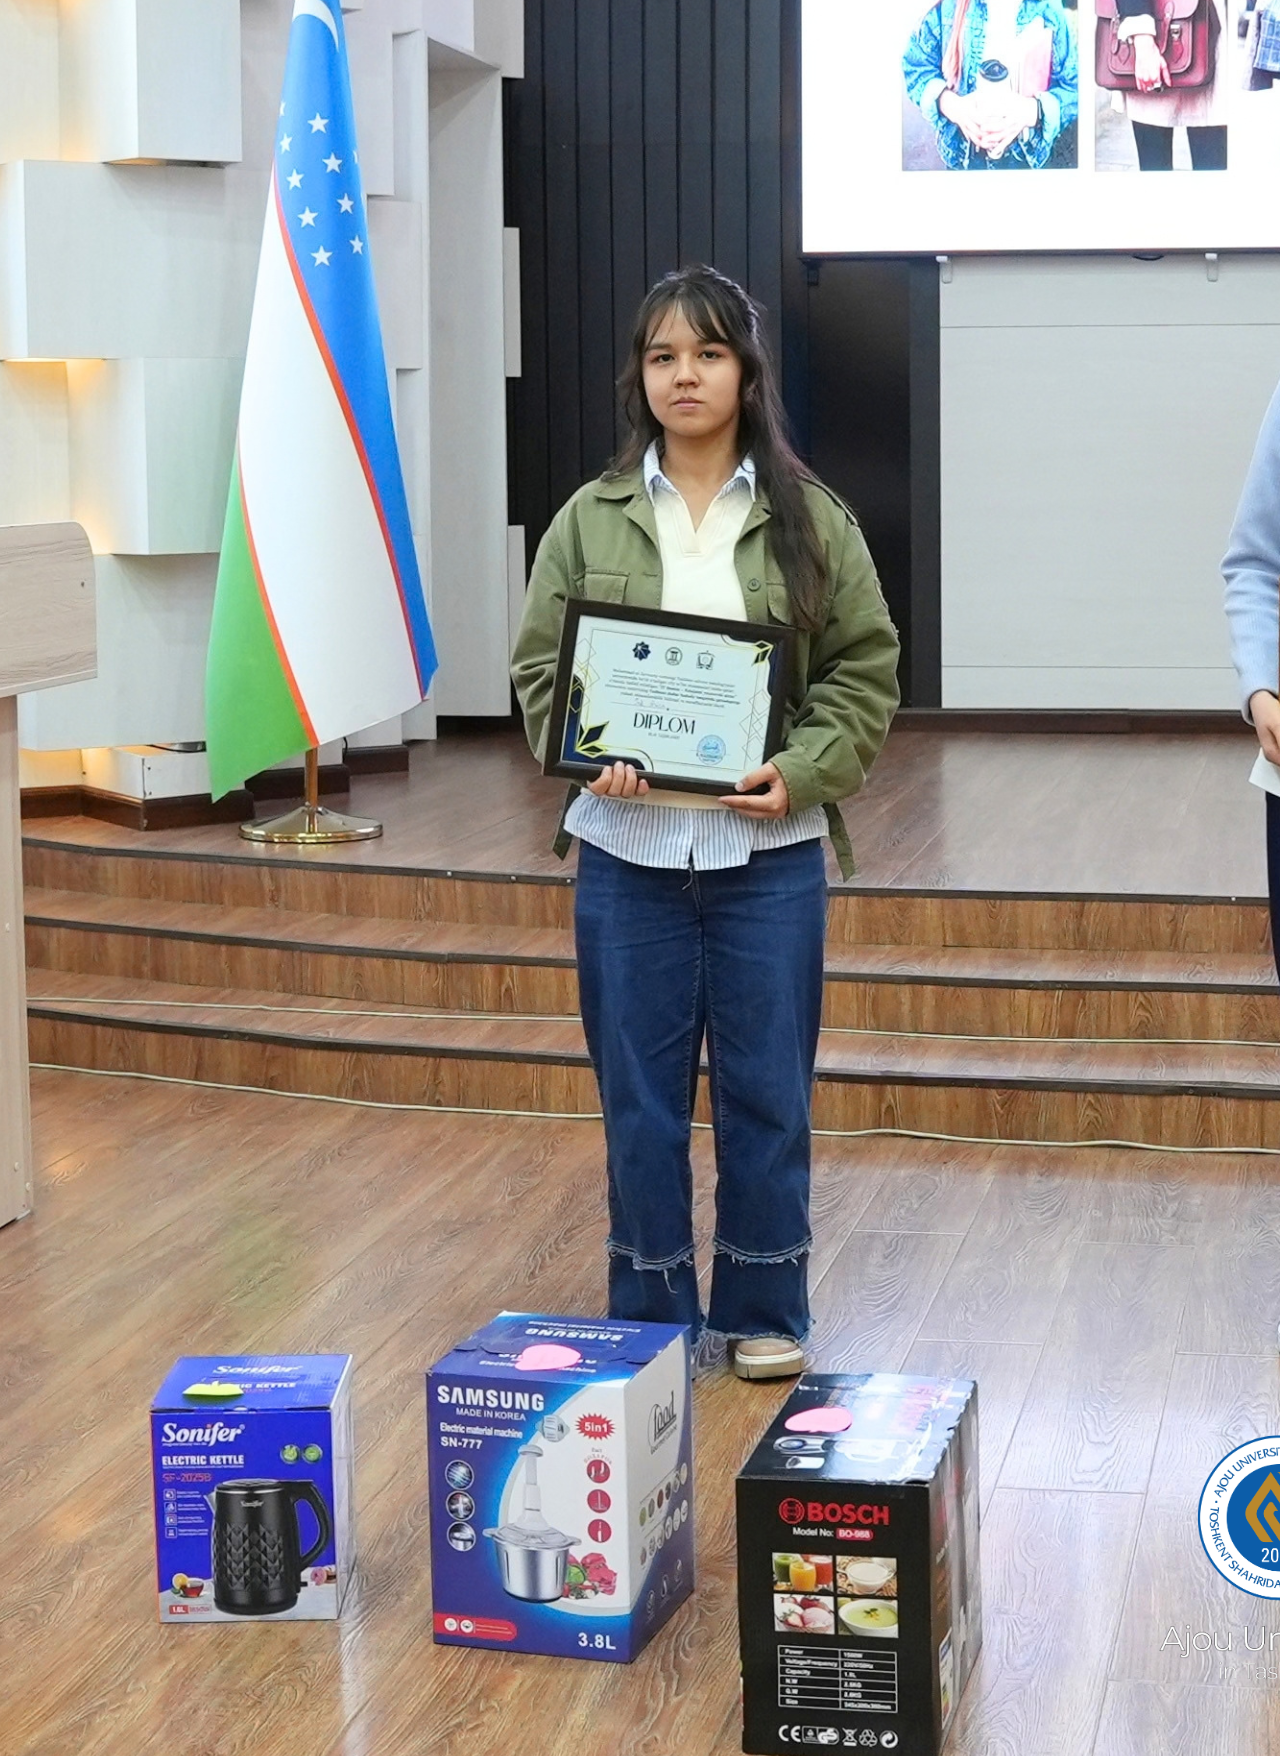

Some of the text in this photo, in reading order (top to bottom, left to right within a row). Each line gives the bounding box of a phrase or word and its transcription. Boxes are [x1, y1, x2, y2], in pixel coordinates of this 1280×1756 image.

[633, 712, 696, 735] DIPLOM
[525, 1328, 623, 1341] SAMSUNG
[437, 1385, 545, 1412] SAMSUNG
[455, 1407, 527, 1422] MADE IN KOREA
[161, 1421, 242, 1447] Sonifer
[440, 1422, 523, 1439] Electric material machine
[440, 1436, 482, 1449] SN-777
[161, 1454, 244, 1466] ELECTRIC KETTLE
[807, 1502, 890, 1526] BOSCH
[792, 1527, 818, 1537] Model
[819, 1528, 834, 1537] No:
[577, 1632, 617, 1650] 3.8L
[784, 1668, 811, 1676] Capacity
